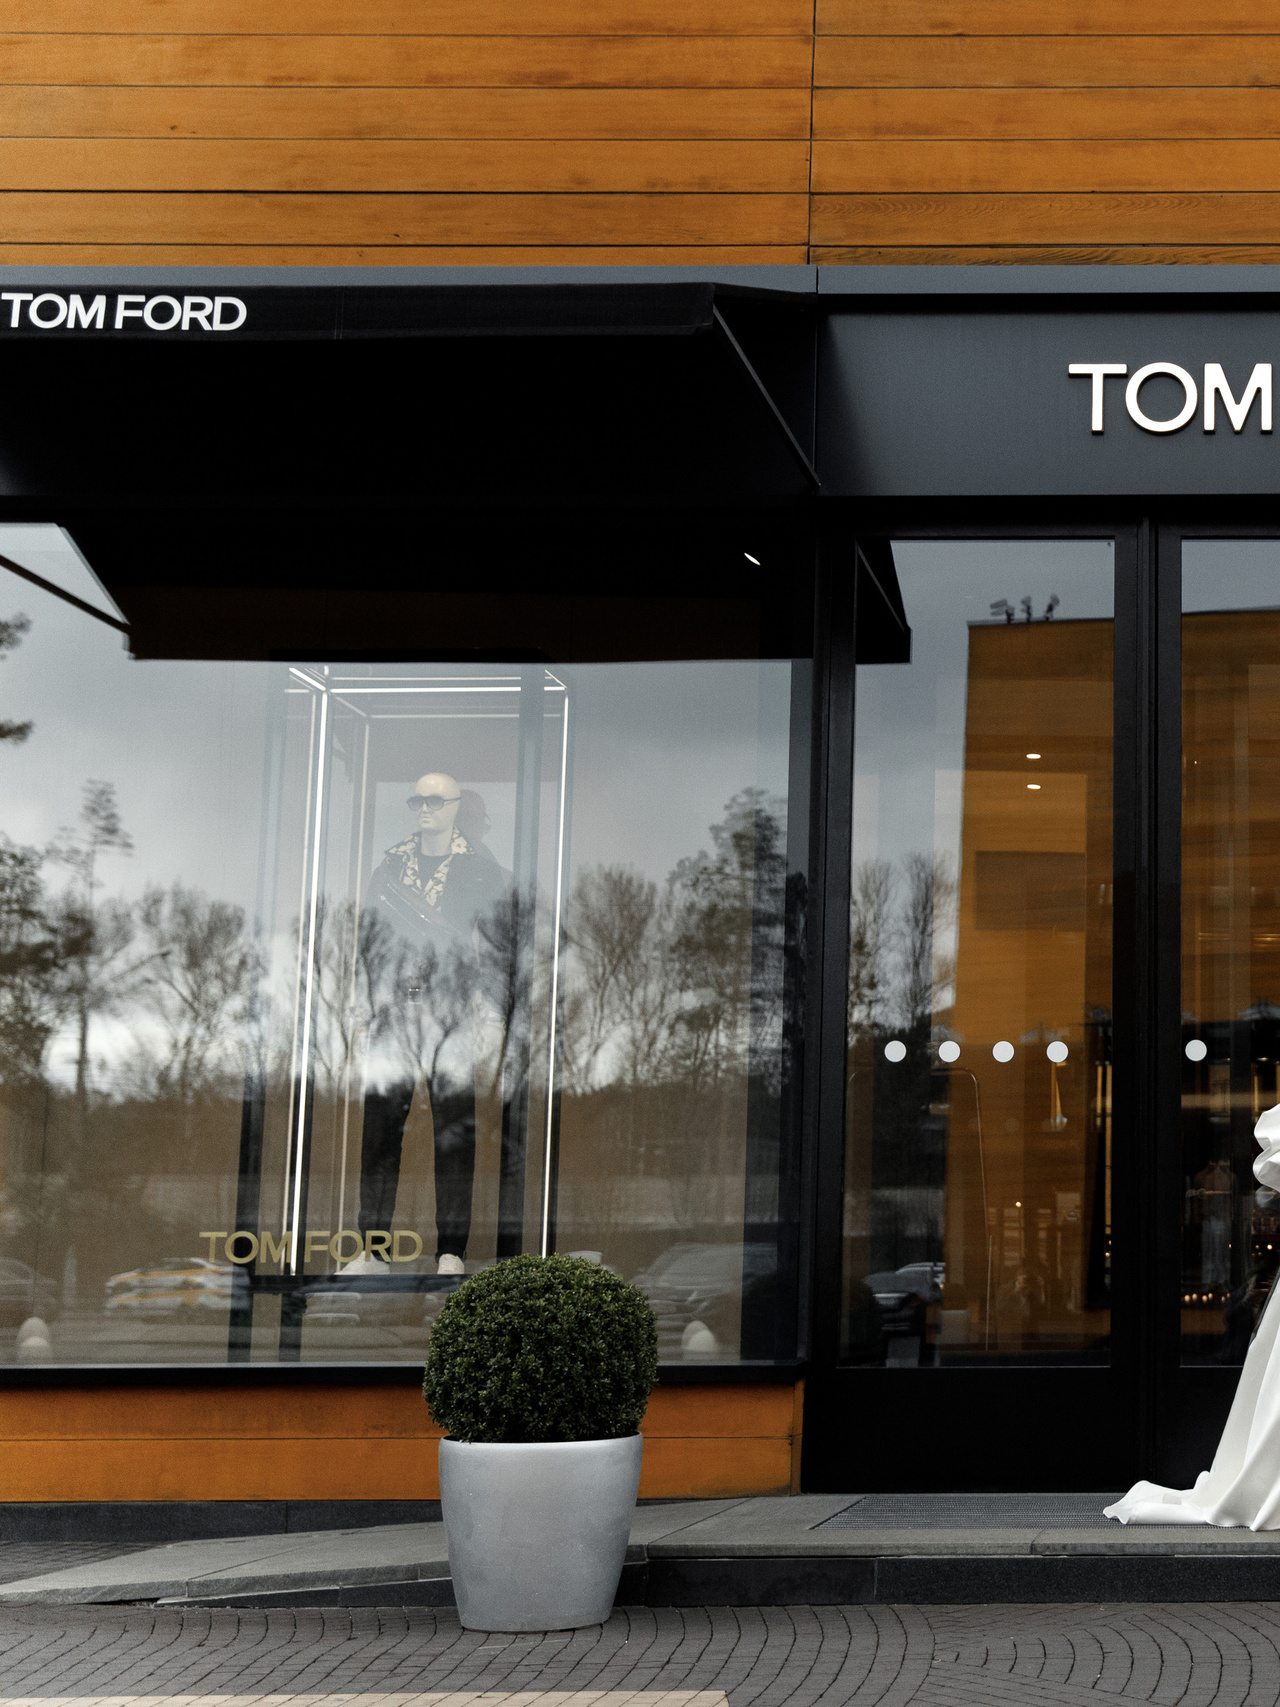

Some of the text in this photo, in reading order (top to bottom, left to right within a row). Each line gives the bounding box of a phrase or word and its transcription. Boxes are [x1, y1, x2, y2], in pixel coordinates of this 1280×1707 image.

[1, 293, 247, 331] TOM FORD
[1068, 362, 1273, 433] TOM
[199, 1229, 423, 1264] TOM FORD
